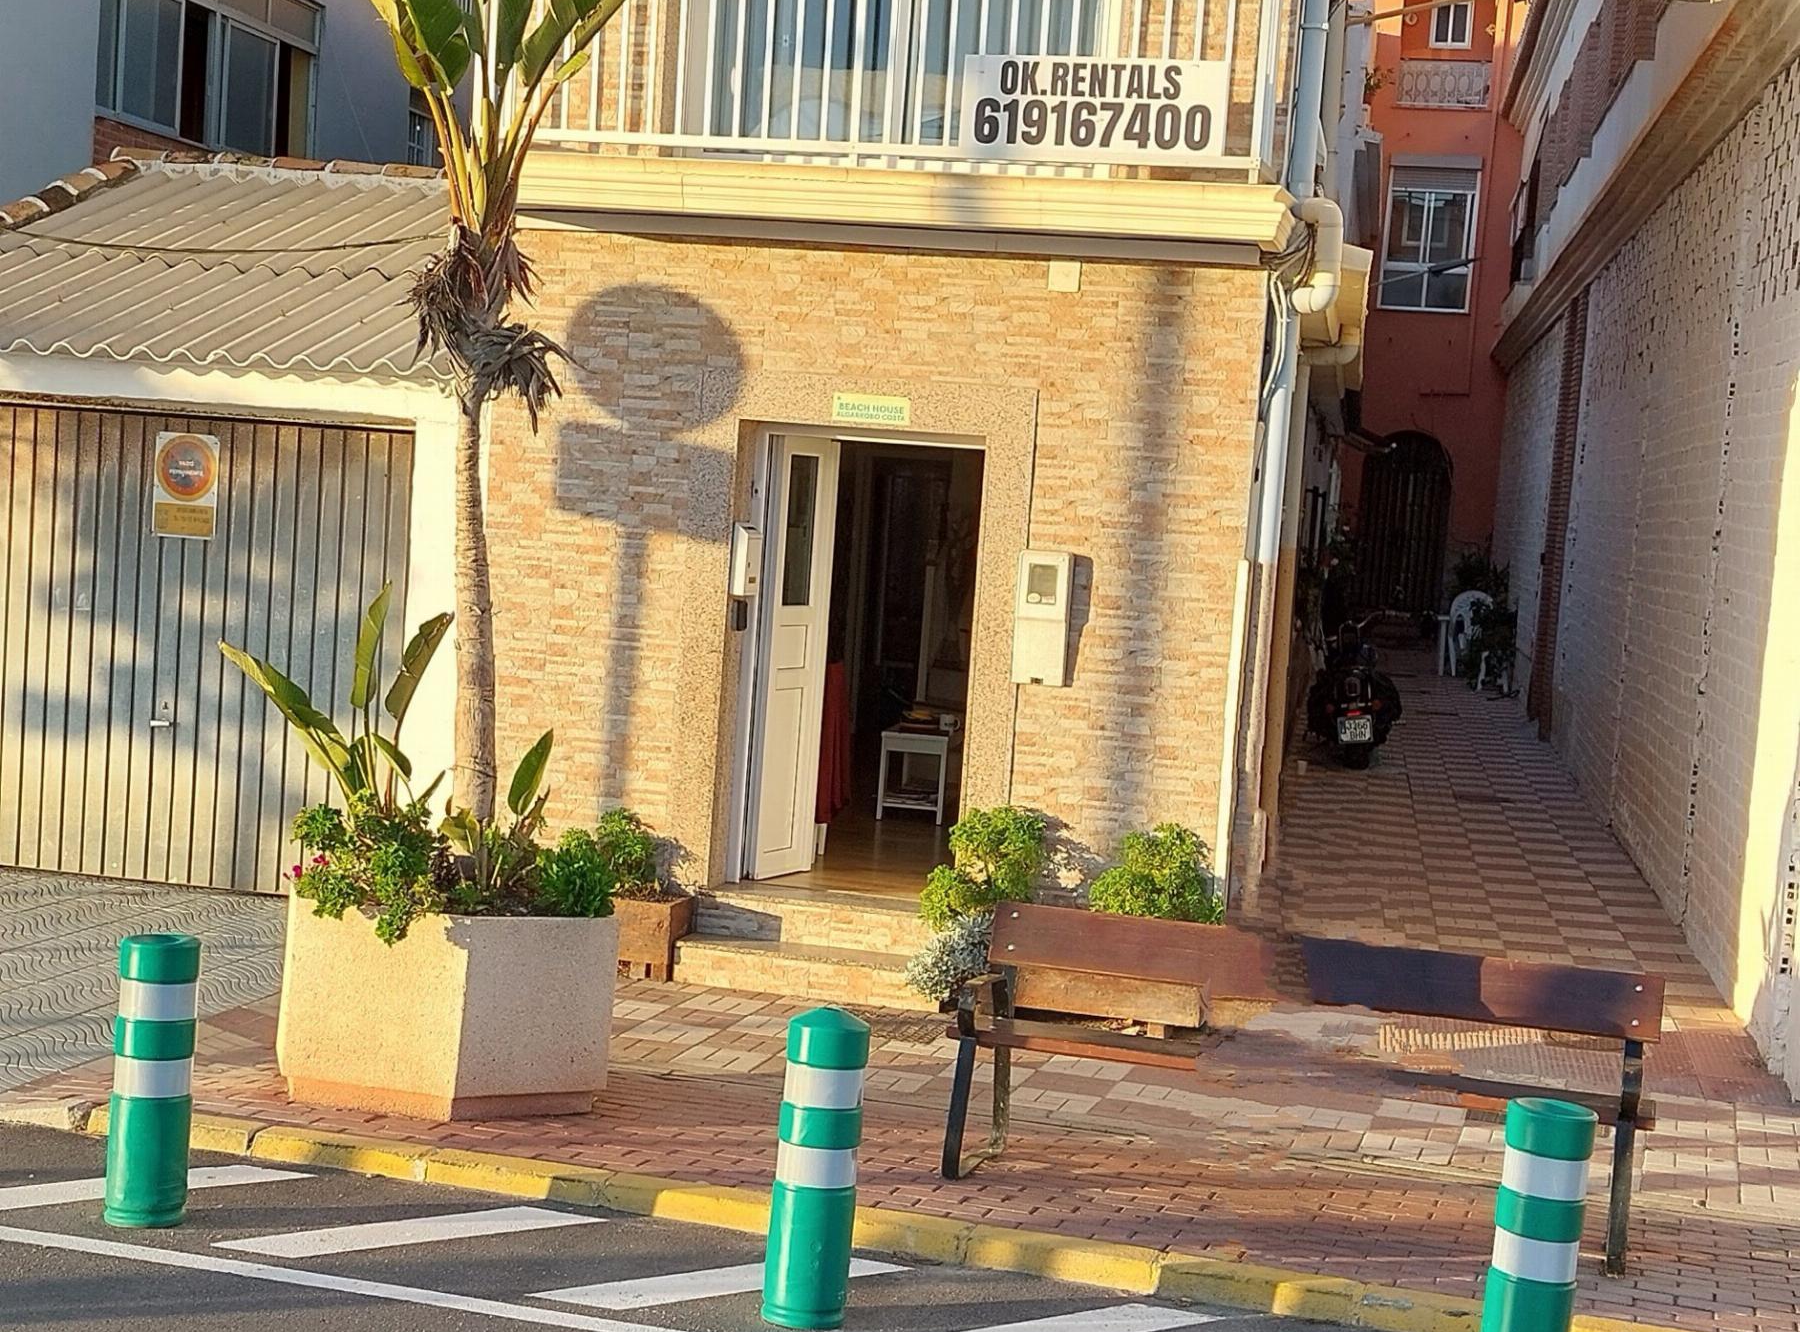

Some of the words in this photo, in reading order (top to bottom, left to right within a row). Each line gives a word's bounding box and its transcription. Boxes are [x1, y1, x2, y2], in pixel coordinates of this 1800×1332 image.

[1000, 60, 1182, 100] OK.RENTALS
[973, 97, 1212, 151] 619167400
[839, 402, 870, 412] BEACH
[872, 405, 905, 415] HOUSE
[881, 414, 905, 422] COSTA
